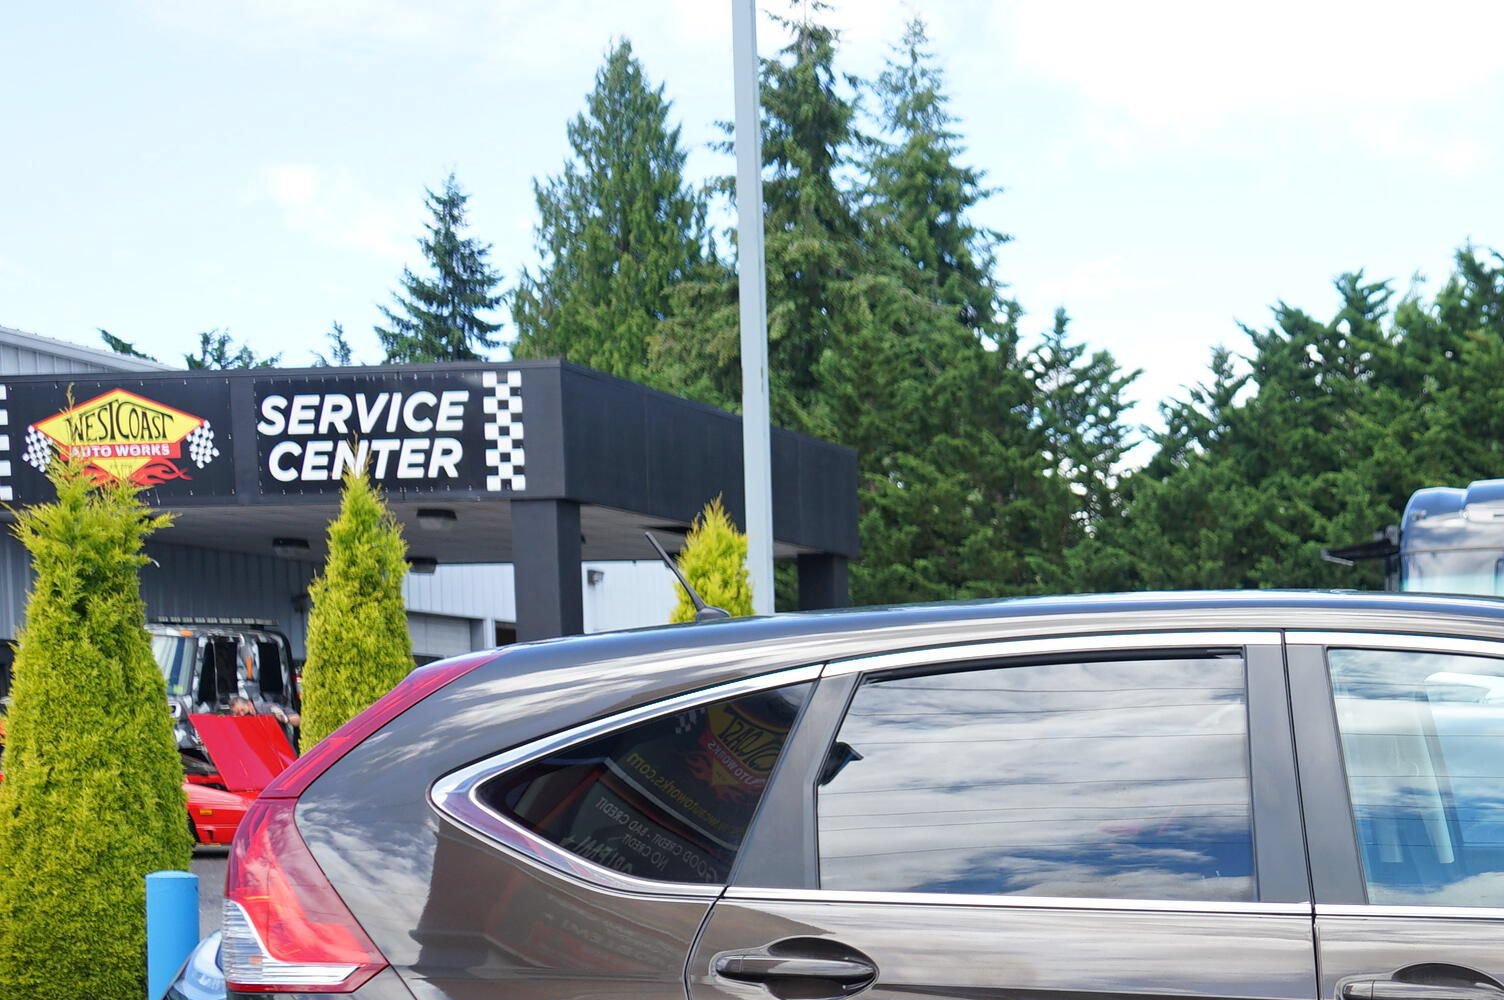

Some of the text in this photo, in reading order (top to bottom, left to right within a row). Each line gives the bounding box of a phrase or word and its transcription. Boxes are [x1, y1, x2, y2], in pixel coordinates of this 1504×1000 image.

[257, 390, 469, 436] SERVICE
[71, 443, 170, 457] AUTO WORKS
[269, 437, 463, 482] CENTER
